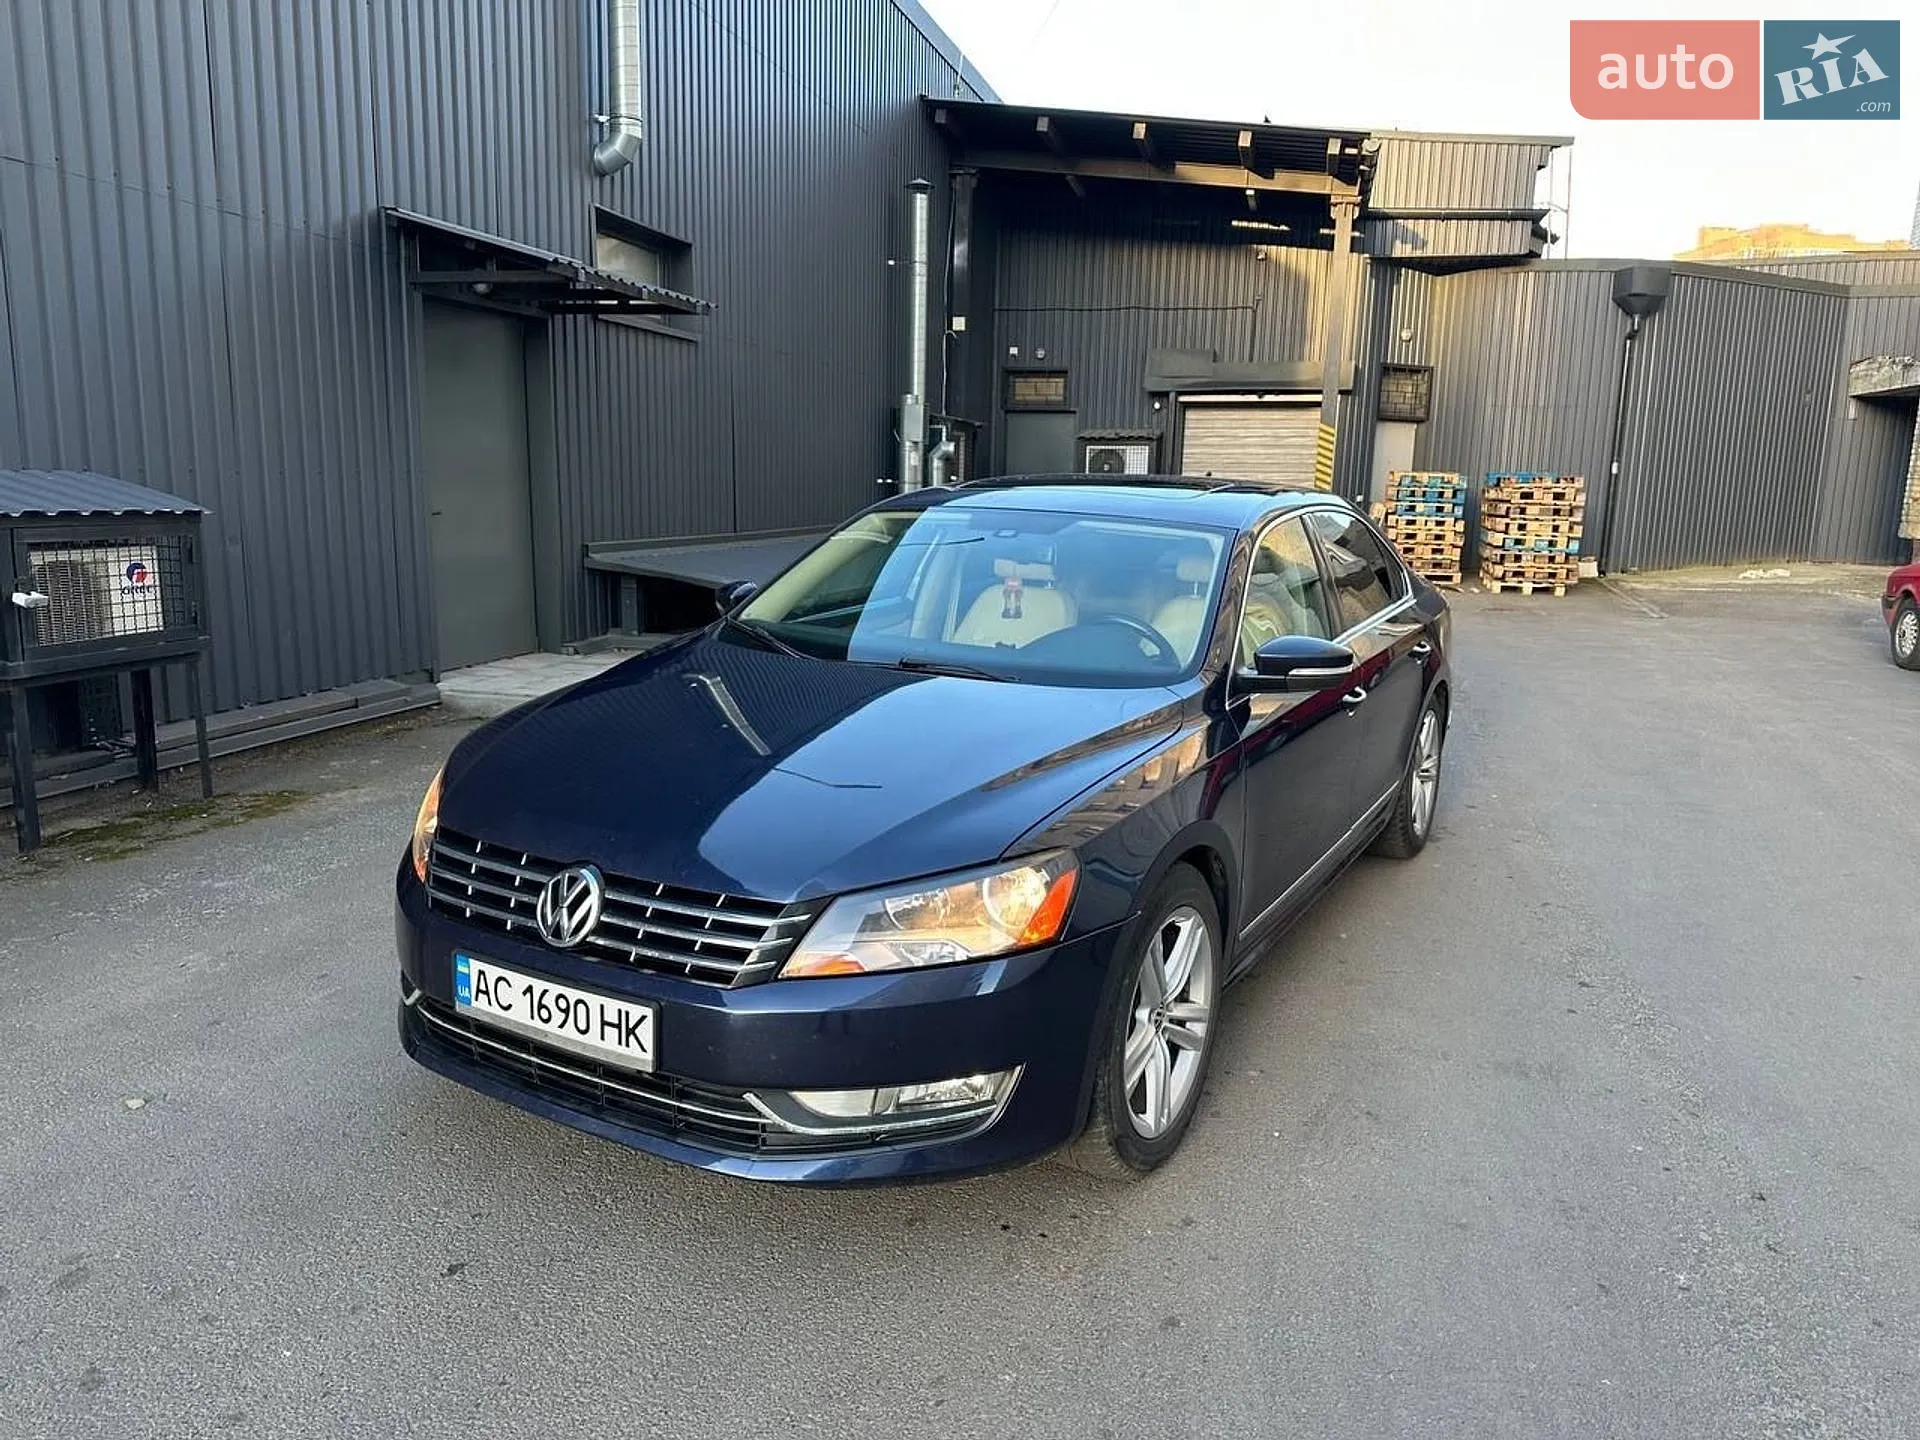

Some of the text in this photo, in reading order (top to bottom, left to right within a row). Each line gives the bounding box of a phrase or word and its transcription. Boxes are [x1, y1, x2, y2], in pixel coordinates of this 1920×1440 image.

[457, 985, 471, 999] UA
[475, 968, 648, 1054] AC 1690 HK
